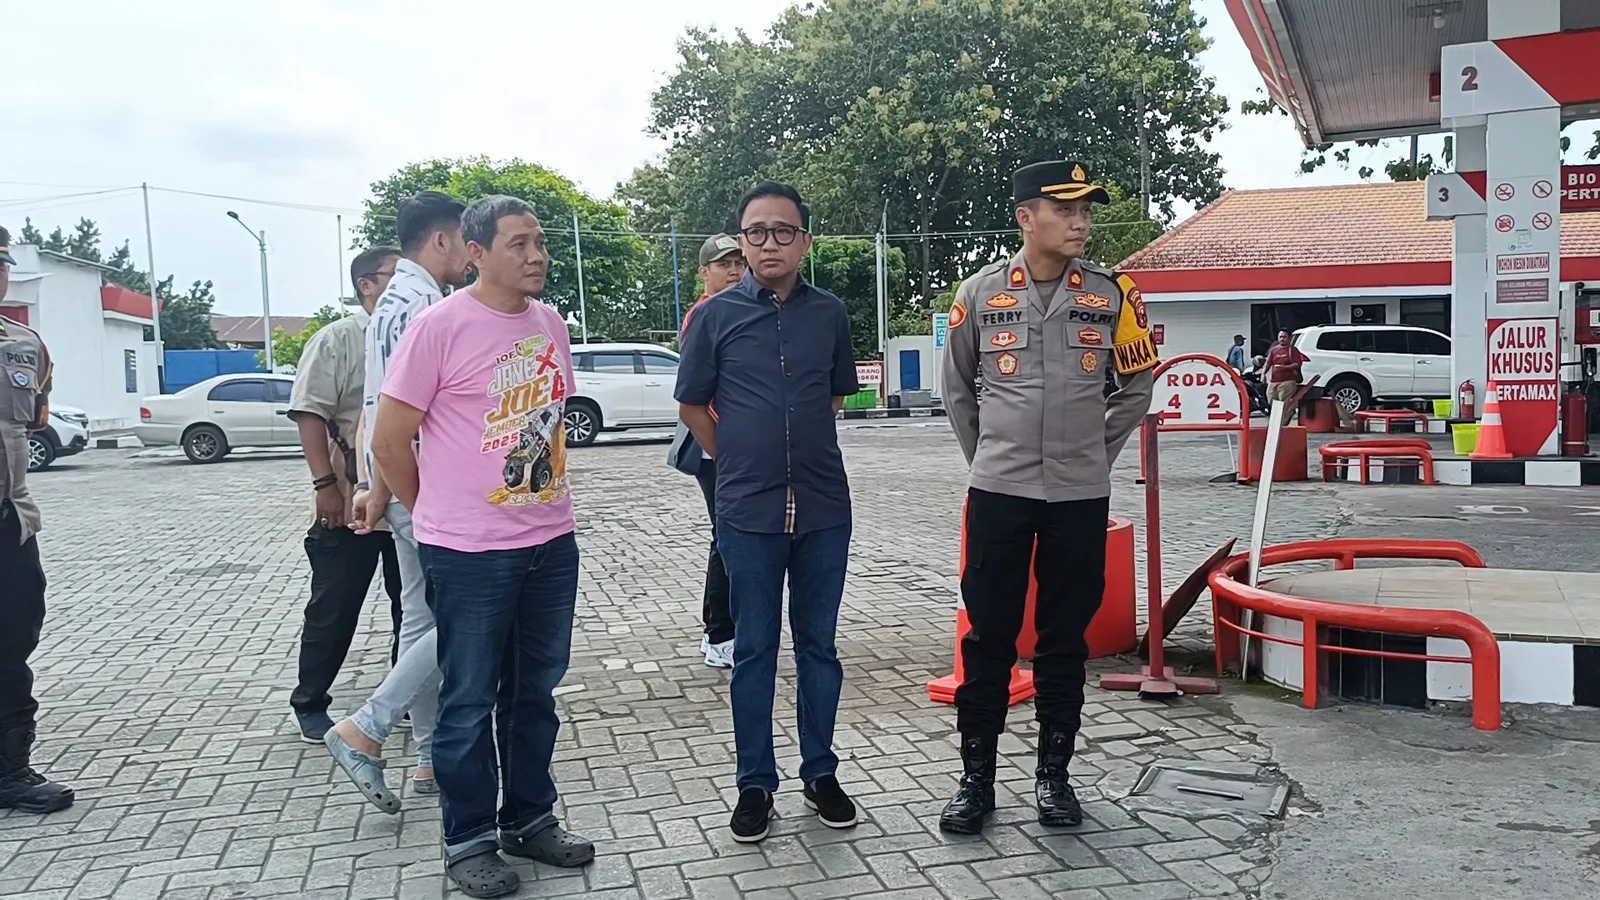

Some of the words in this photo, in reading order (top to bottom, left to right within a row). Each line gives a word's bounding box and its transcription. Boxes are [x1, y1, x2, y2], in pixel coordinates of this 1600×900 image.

[1461, 66, 1478, 91] 2
[1568, 173, 1597, 185] BIO
[1438, 187, 1449, 202] 3
[983, 311, 1022, 325] FERRY
[1069, 310, 1113, 324] POLRI
[1497, 326, 1546, 349] JALUR
[1115, 338, 1152, 370] WAKA
[1491, 351, 1553, 375] KHUSUS
[489, 356, 536, 396] JANE
[535, 343, 558, 375] X
[1167, 373, 1225, 387] RODA
[486, 375, 549, 423] JOE
[1168, 393, 1181, 409] 4
[1207, 393, 1220, 409] 2
[1497, 384, 1556, 401] ERTAMAX
[484, 416, 525, 437] JEMBER
[481, 431, 518, 452] 2025
